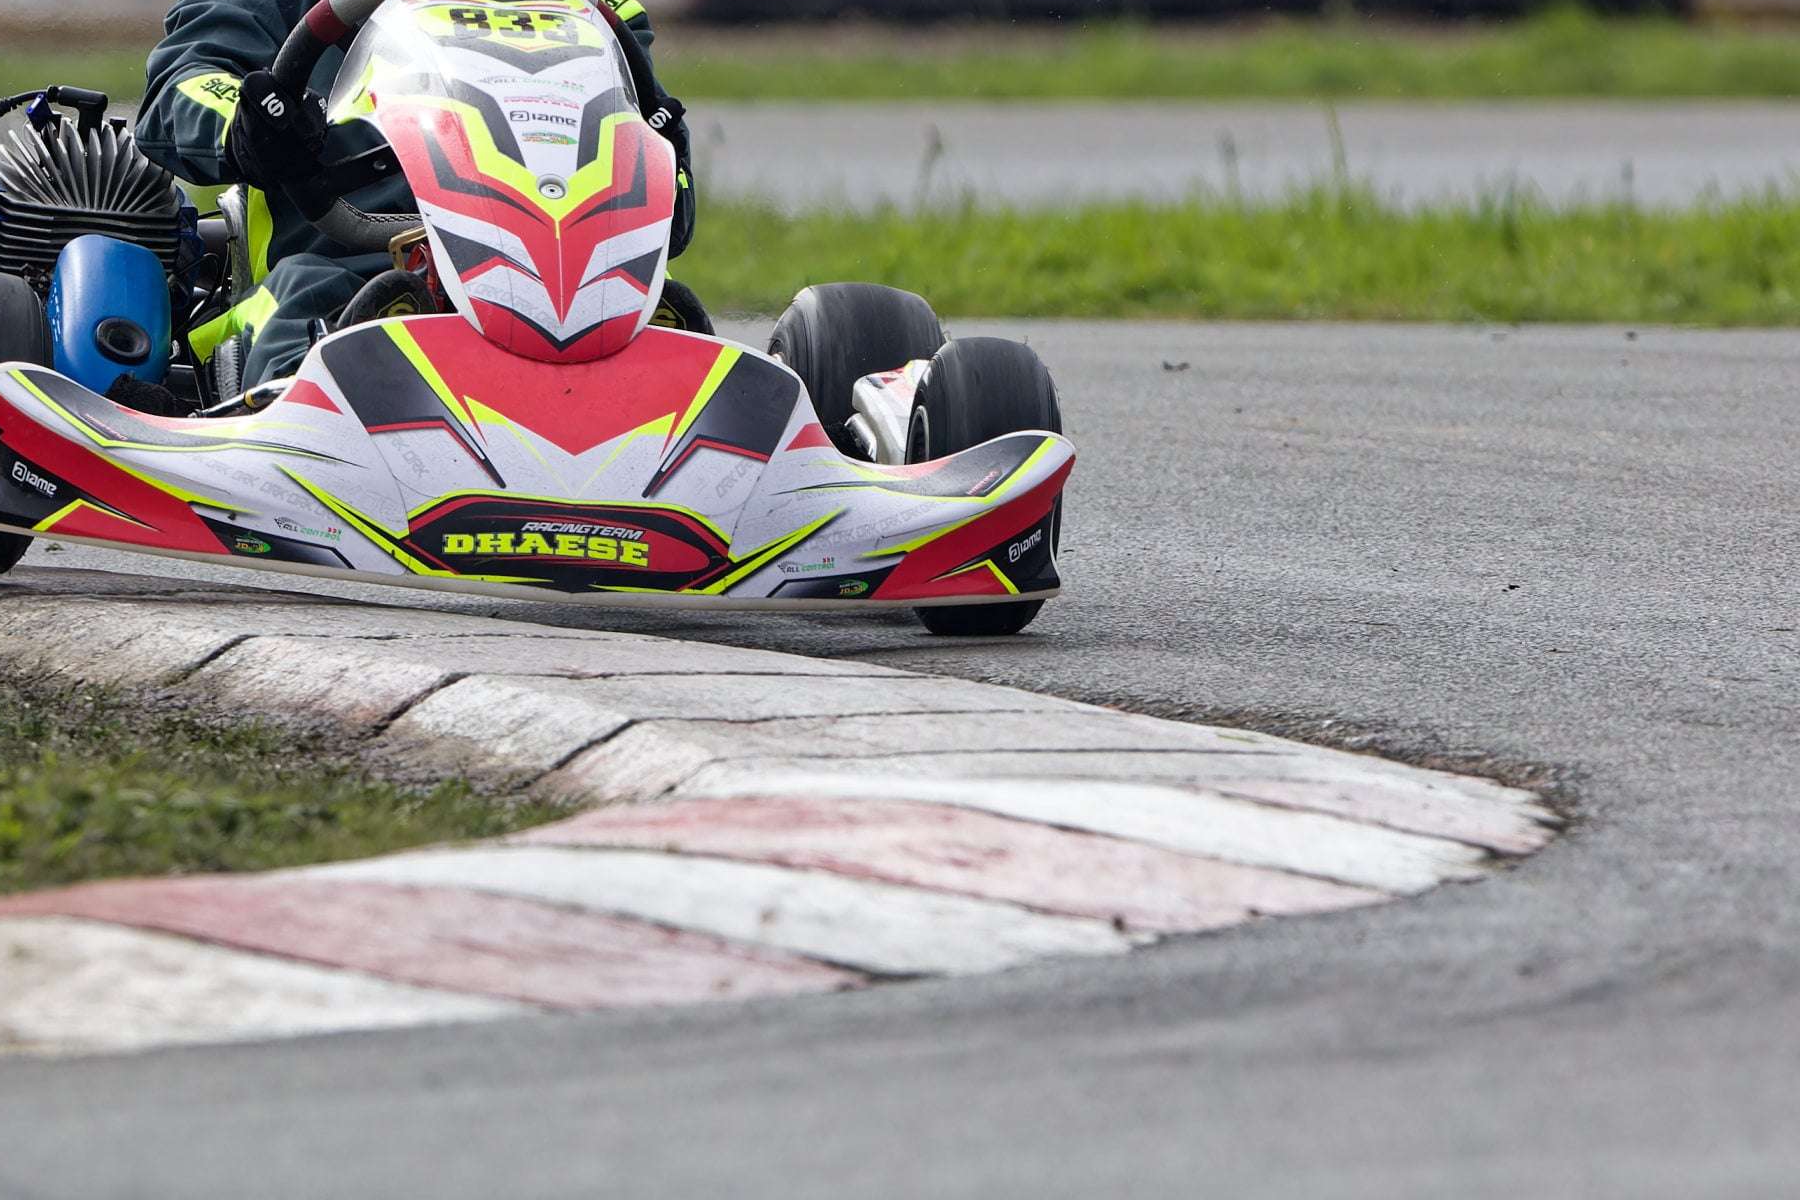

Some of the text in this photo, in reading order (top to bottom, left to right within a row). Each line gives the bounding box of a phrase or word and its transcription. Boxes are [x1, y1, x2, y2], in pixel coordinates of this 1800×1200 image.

[25, 471, 58, 496] iame
[521, 521, 646, 540] RACINGTEAM
[442, 532, 650, 568] DHAESE
